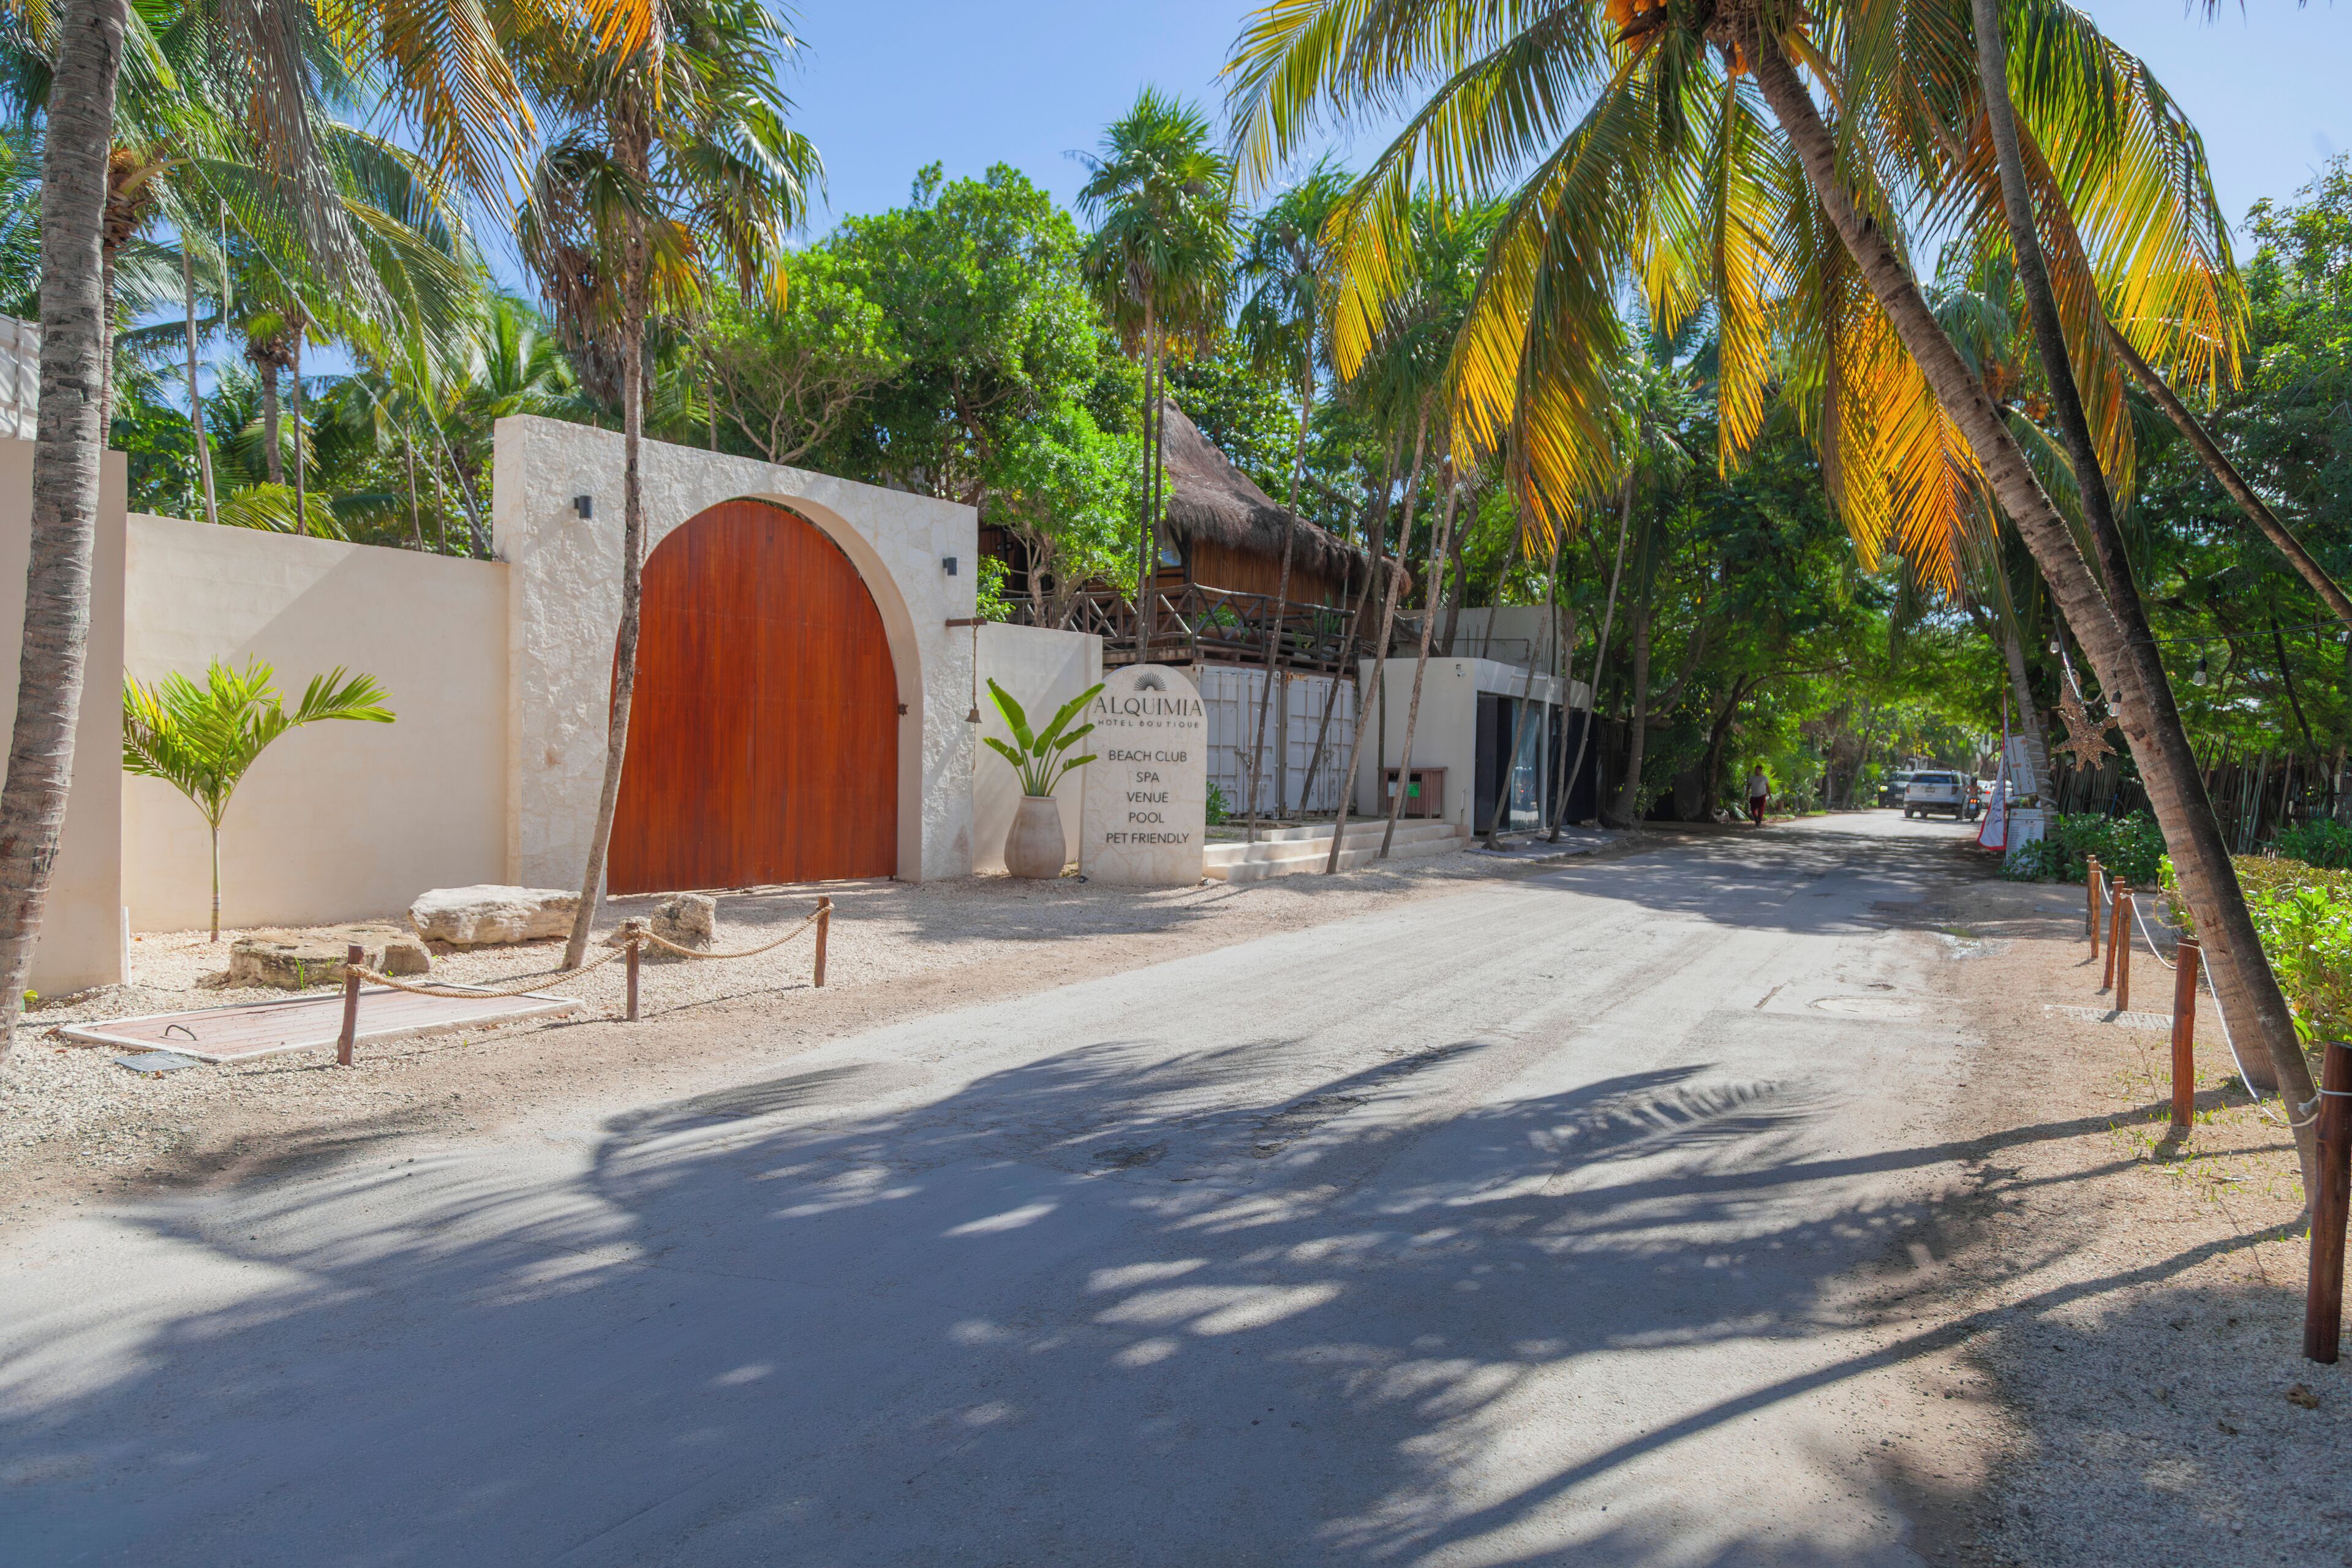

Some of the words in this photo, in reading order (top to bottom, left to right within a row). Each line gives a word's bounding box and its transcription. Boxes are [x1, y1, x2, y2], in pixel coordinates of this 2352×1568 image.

[1093, 696, 1203, 717] ALQUIMIA
[1098, 718, 1133, 727] HOTEL
[1139, 720, 1199, 729] BOUTIQUE
[1108, 749, 1152, 762] BEACH
[1155, 750, 1188, 763] CLUB
[1136, 771, 1160, 783] SPA
[1126, 791, 1169, 803] VENUE
[1128, 812, 1165, 824] POOL
[1106, 832, 1128, 844] PET
[1131, 832, 1189, 844] FRIENDLY
